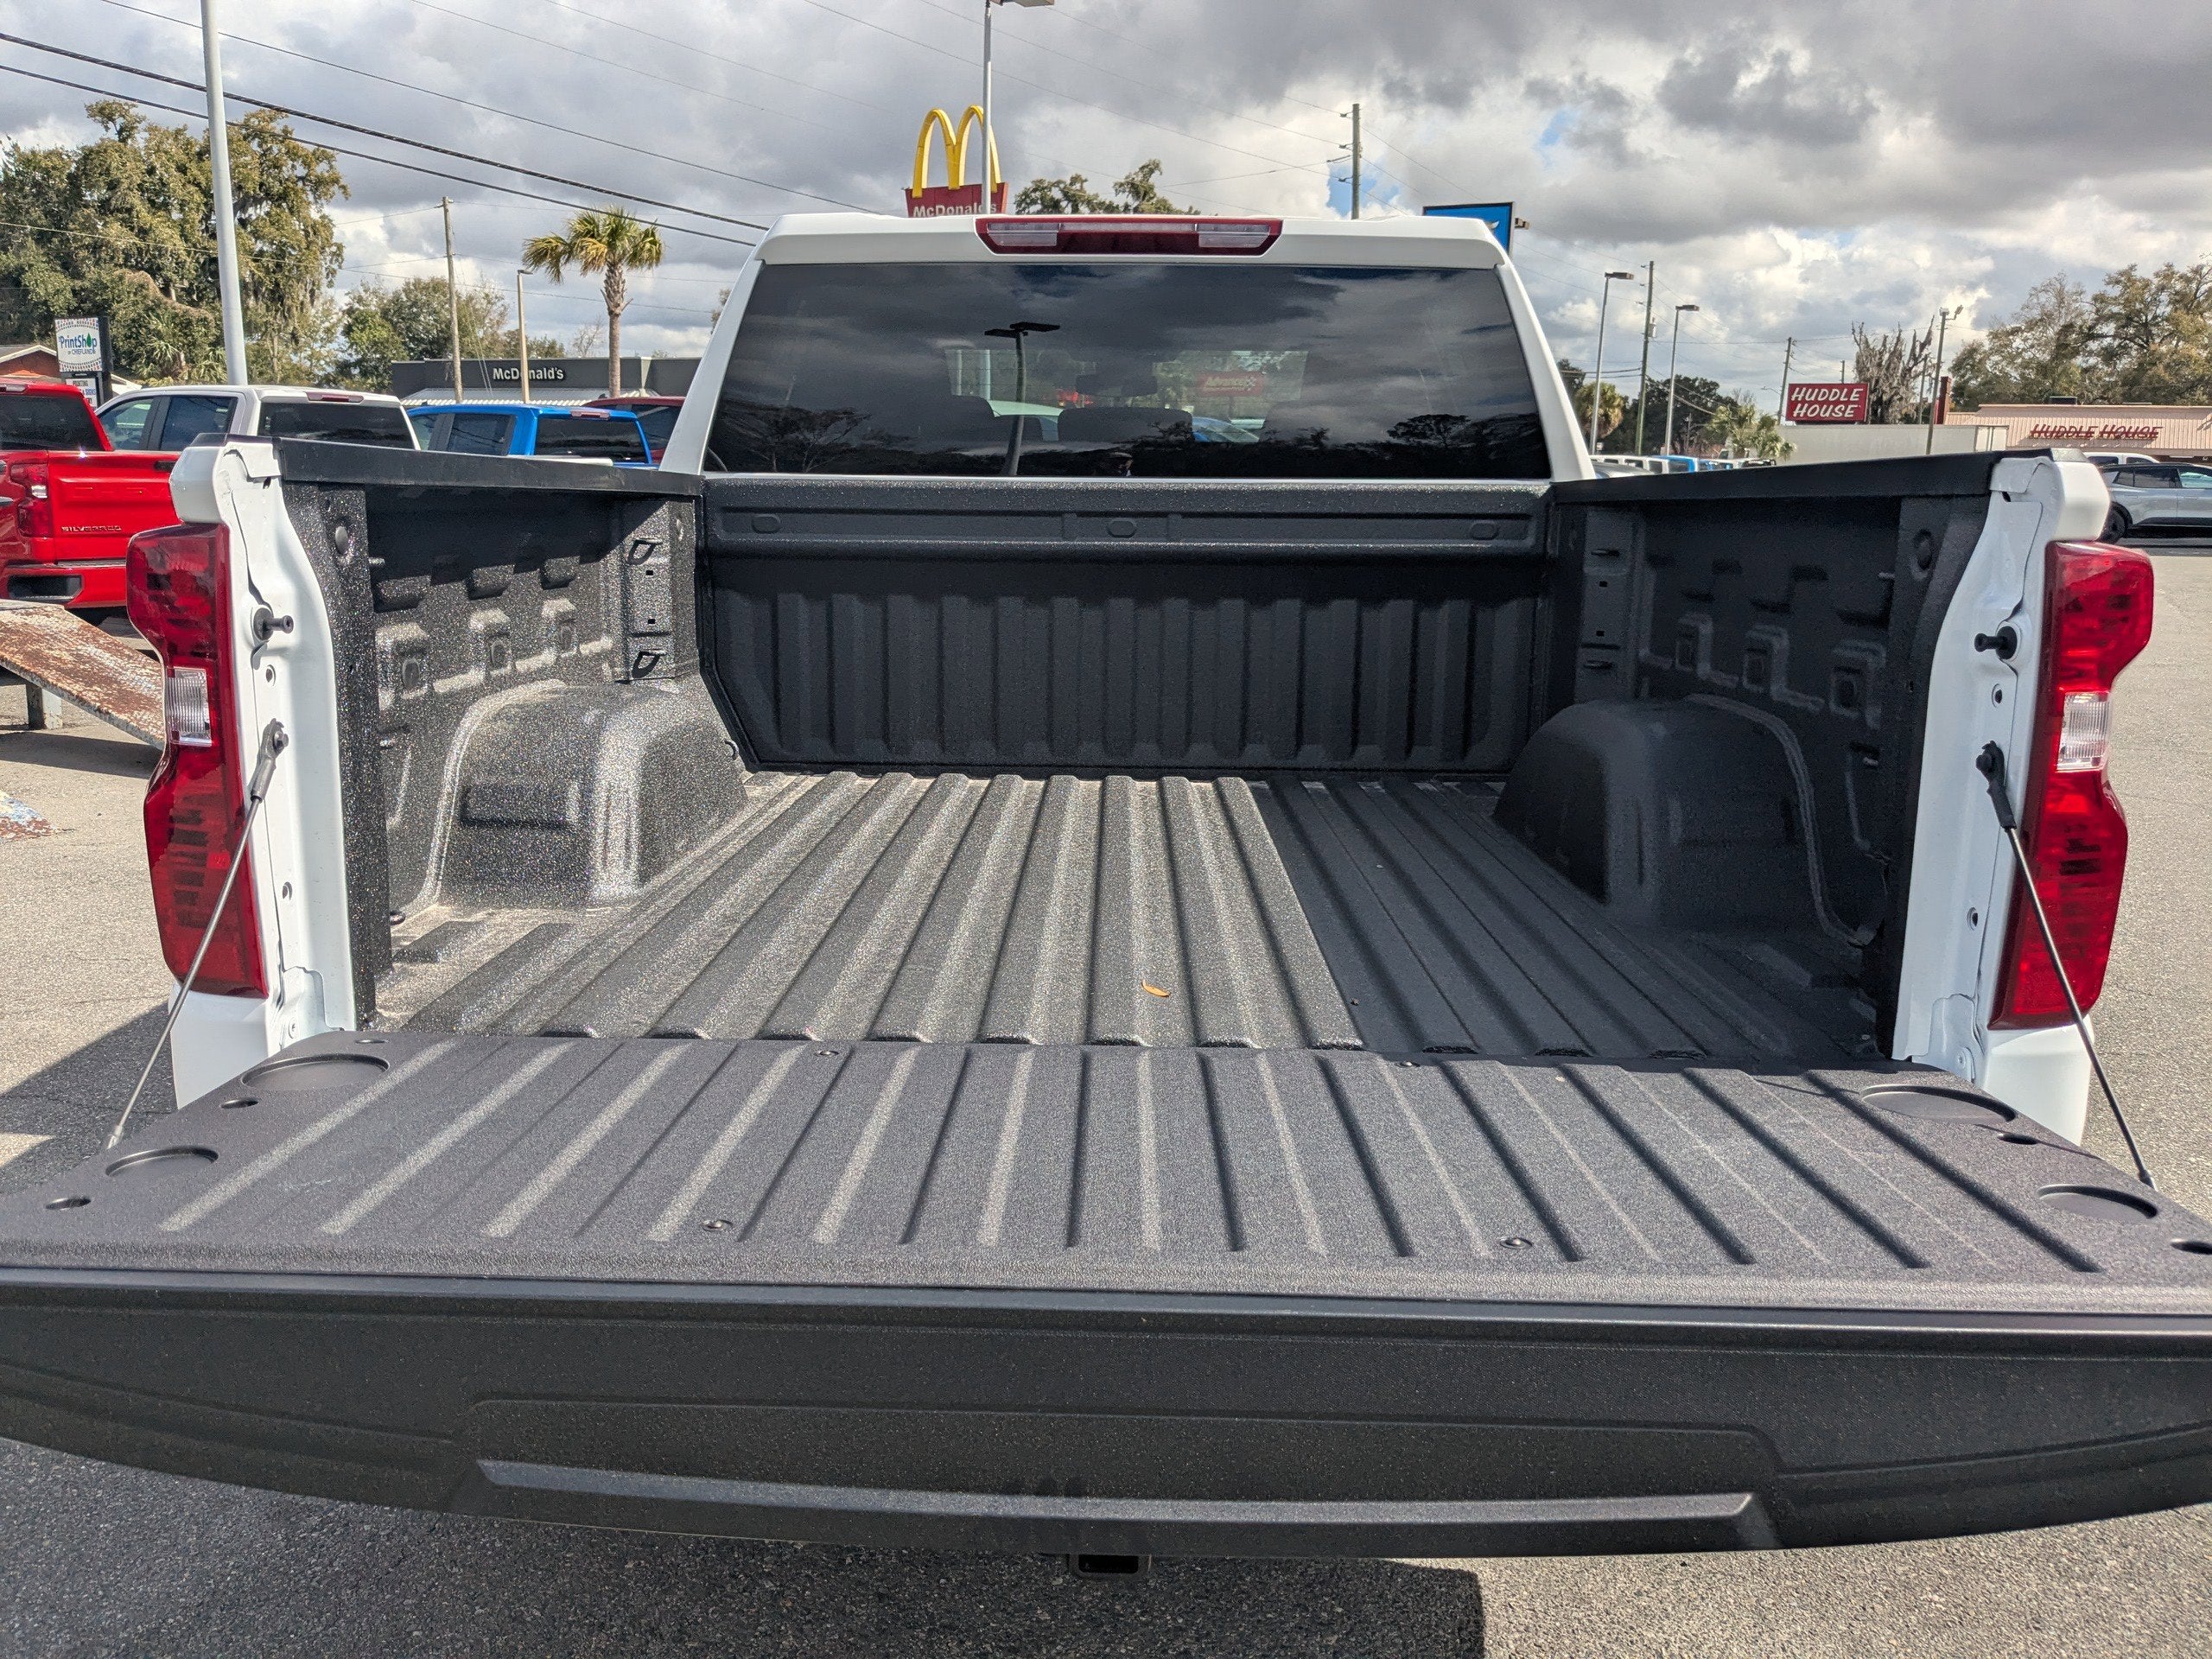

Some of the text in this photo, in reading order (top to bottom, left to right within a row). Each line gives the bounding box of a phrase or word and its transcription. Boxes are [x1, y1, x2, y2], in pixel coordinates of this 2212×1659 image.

[913, 202, 997, 218] McDonals
[493, 367, 564, 380] McDnald's
[1790, 387, 1864, 402] HUDDLE
[1793, 403, 1859, 417] HOUSE
[2031, 423, 2164, 440] HUDDLE HOUSE
